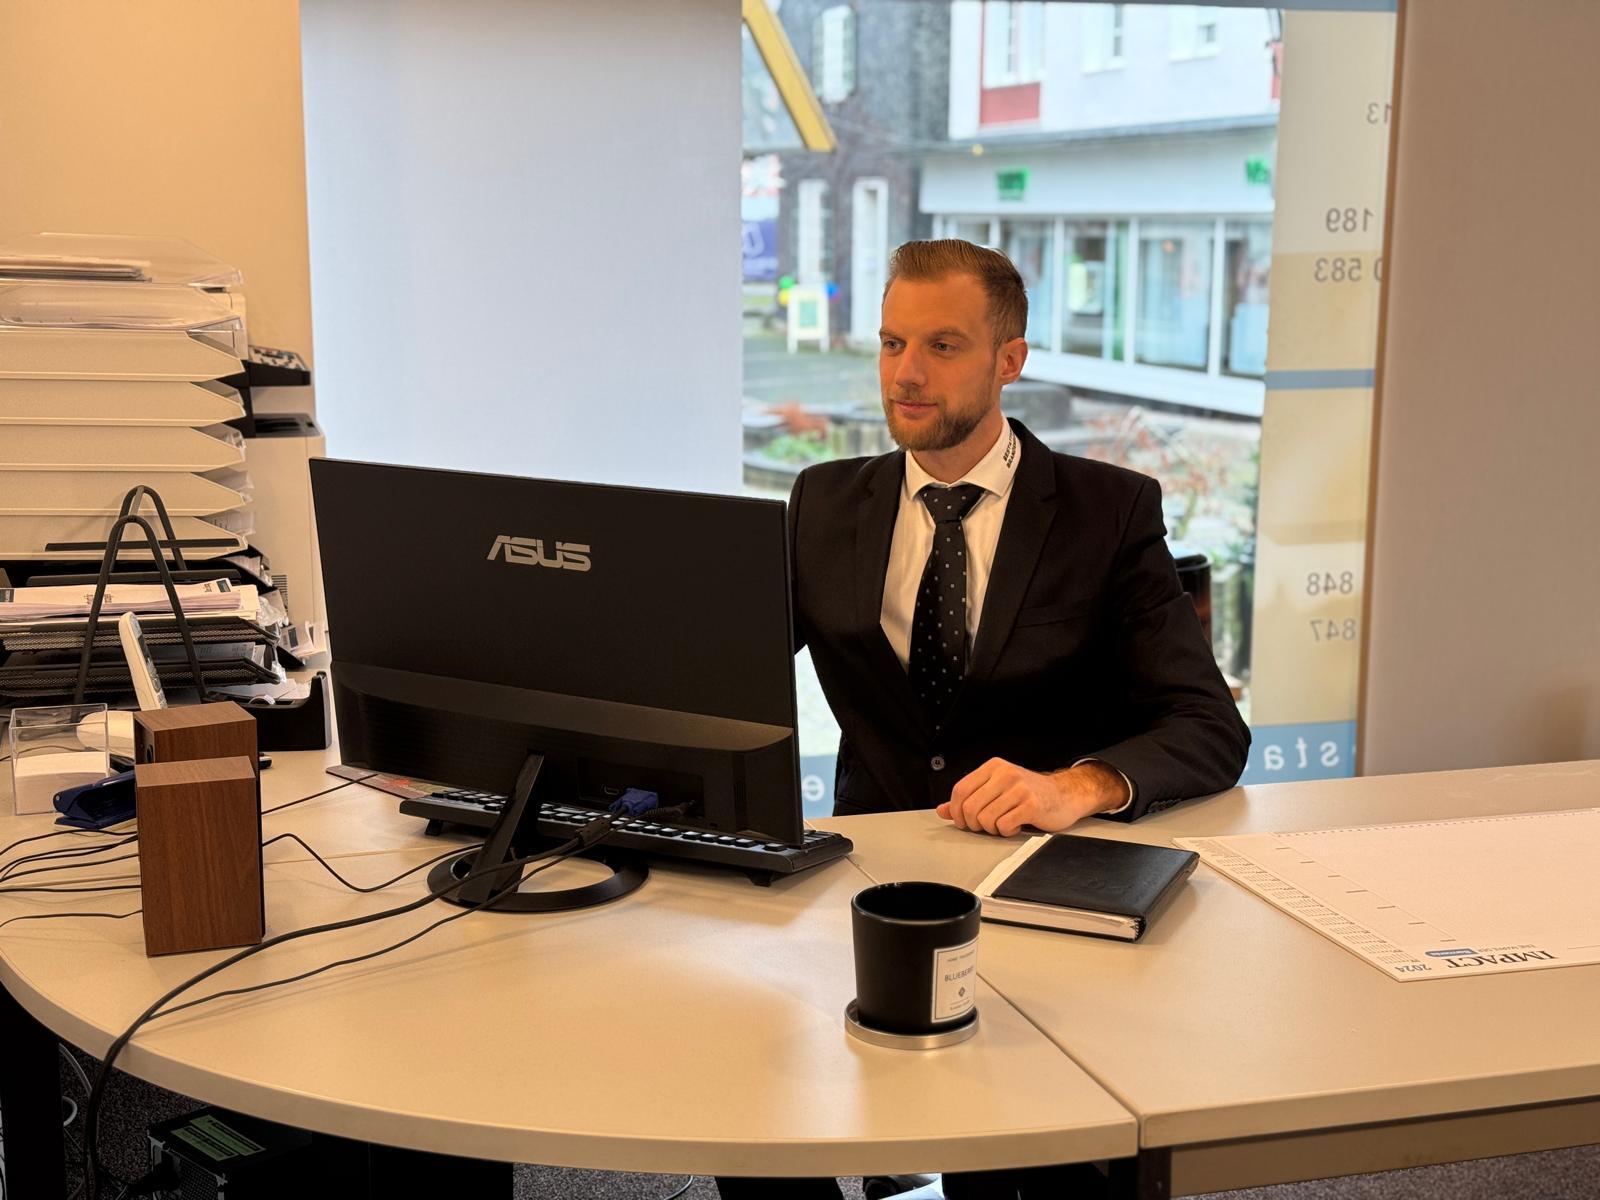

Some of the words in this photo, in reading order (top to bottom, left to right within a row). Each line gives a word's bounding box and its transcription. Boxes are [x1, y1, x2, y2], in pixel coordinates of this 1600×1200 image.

[487, 535, 592, 572] ASUS
[1395, 963, 1432, 973] 2024
[1441, 950, 1557, 969] IMPACT
